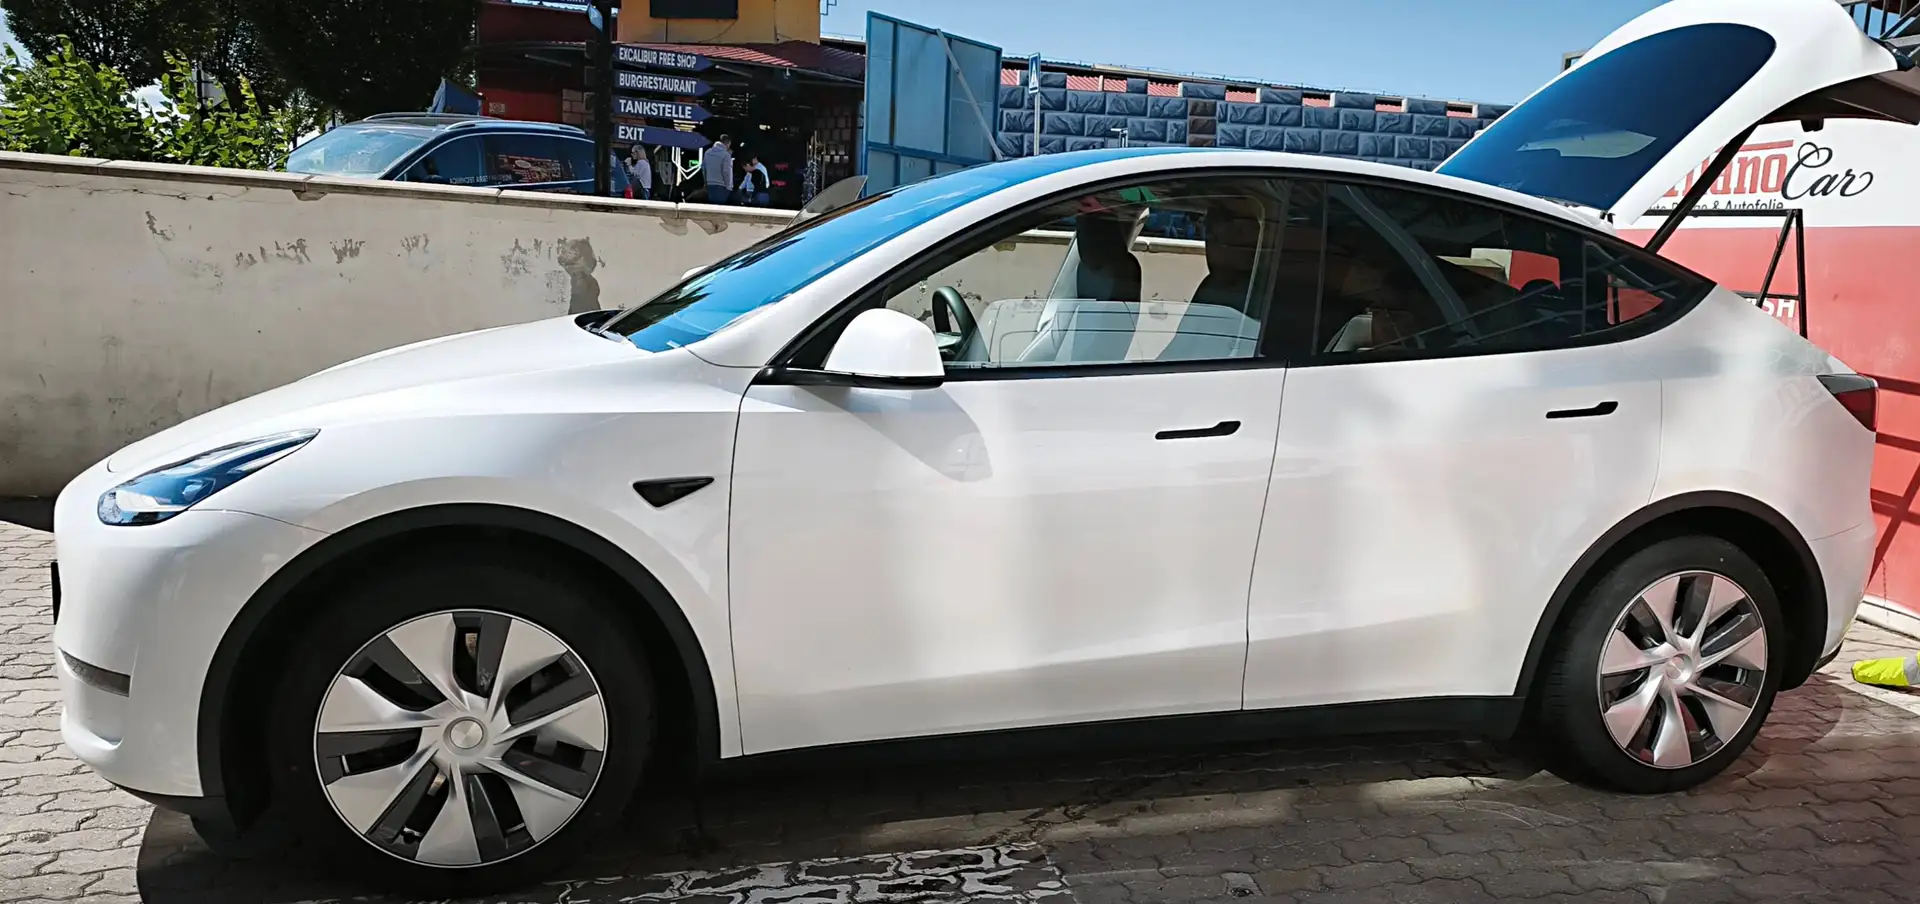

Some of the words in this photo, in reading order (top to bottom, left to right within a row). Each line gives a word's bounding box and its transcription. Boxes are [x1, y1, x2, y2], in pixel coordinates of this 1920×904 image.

[619, 47, 657, 65] EXCALIBUR
[659, 52, 675, 66] FREE
[676, 54, 696, 69] SHOP
[619, 73, 697, 93] BURGRESTAURANT
[619, 99, 692, 119] TANKSTELLE
[618, 126, 645, 141] EXIT
[1781, 142, 1874, 200] Car
